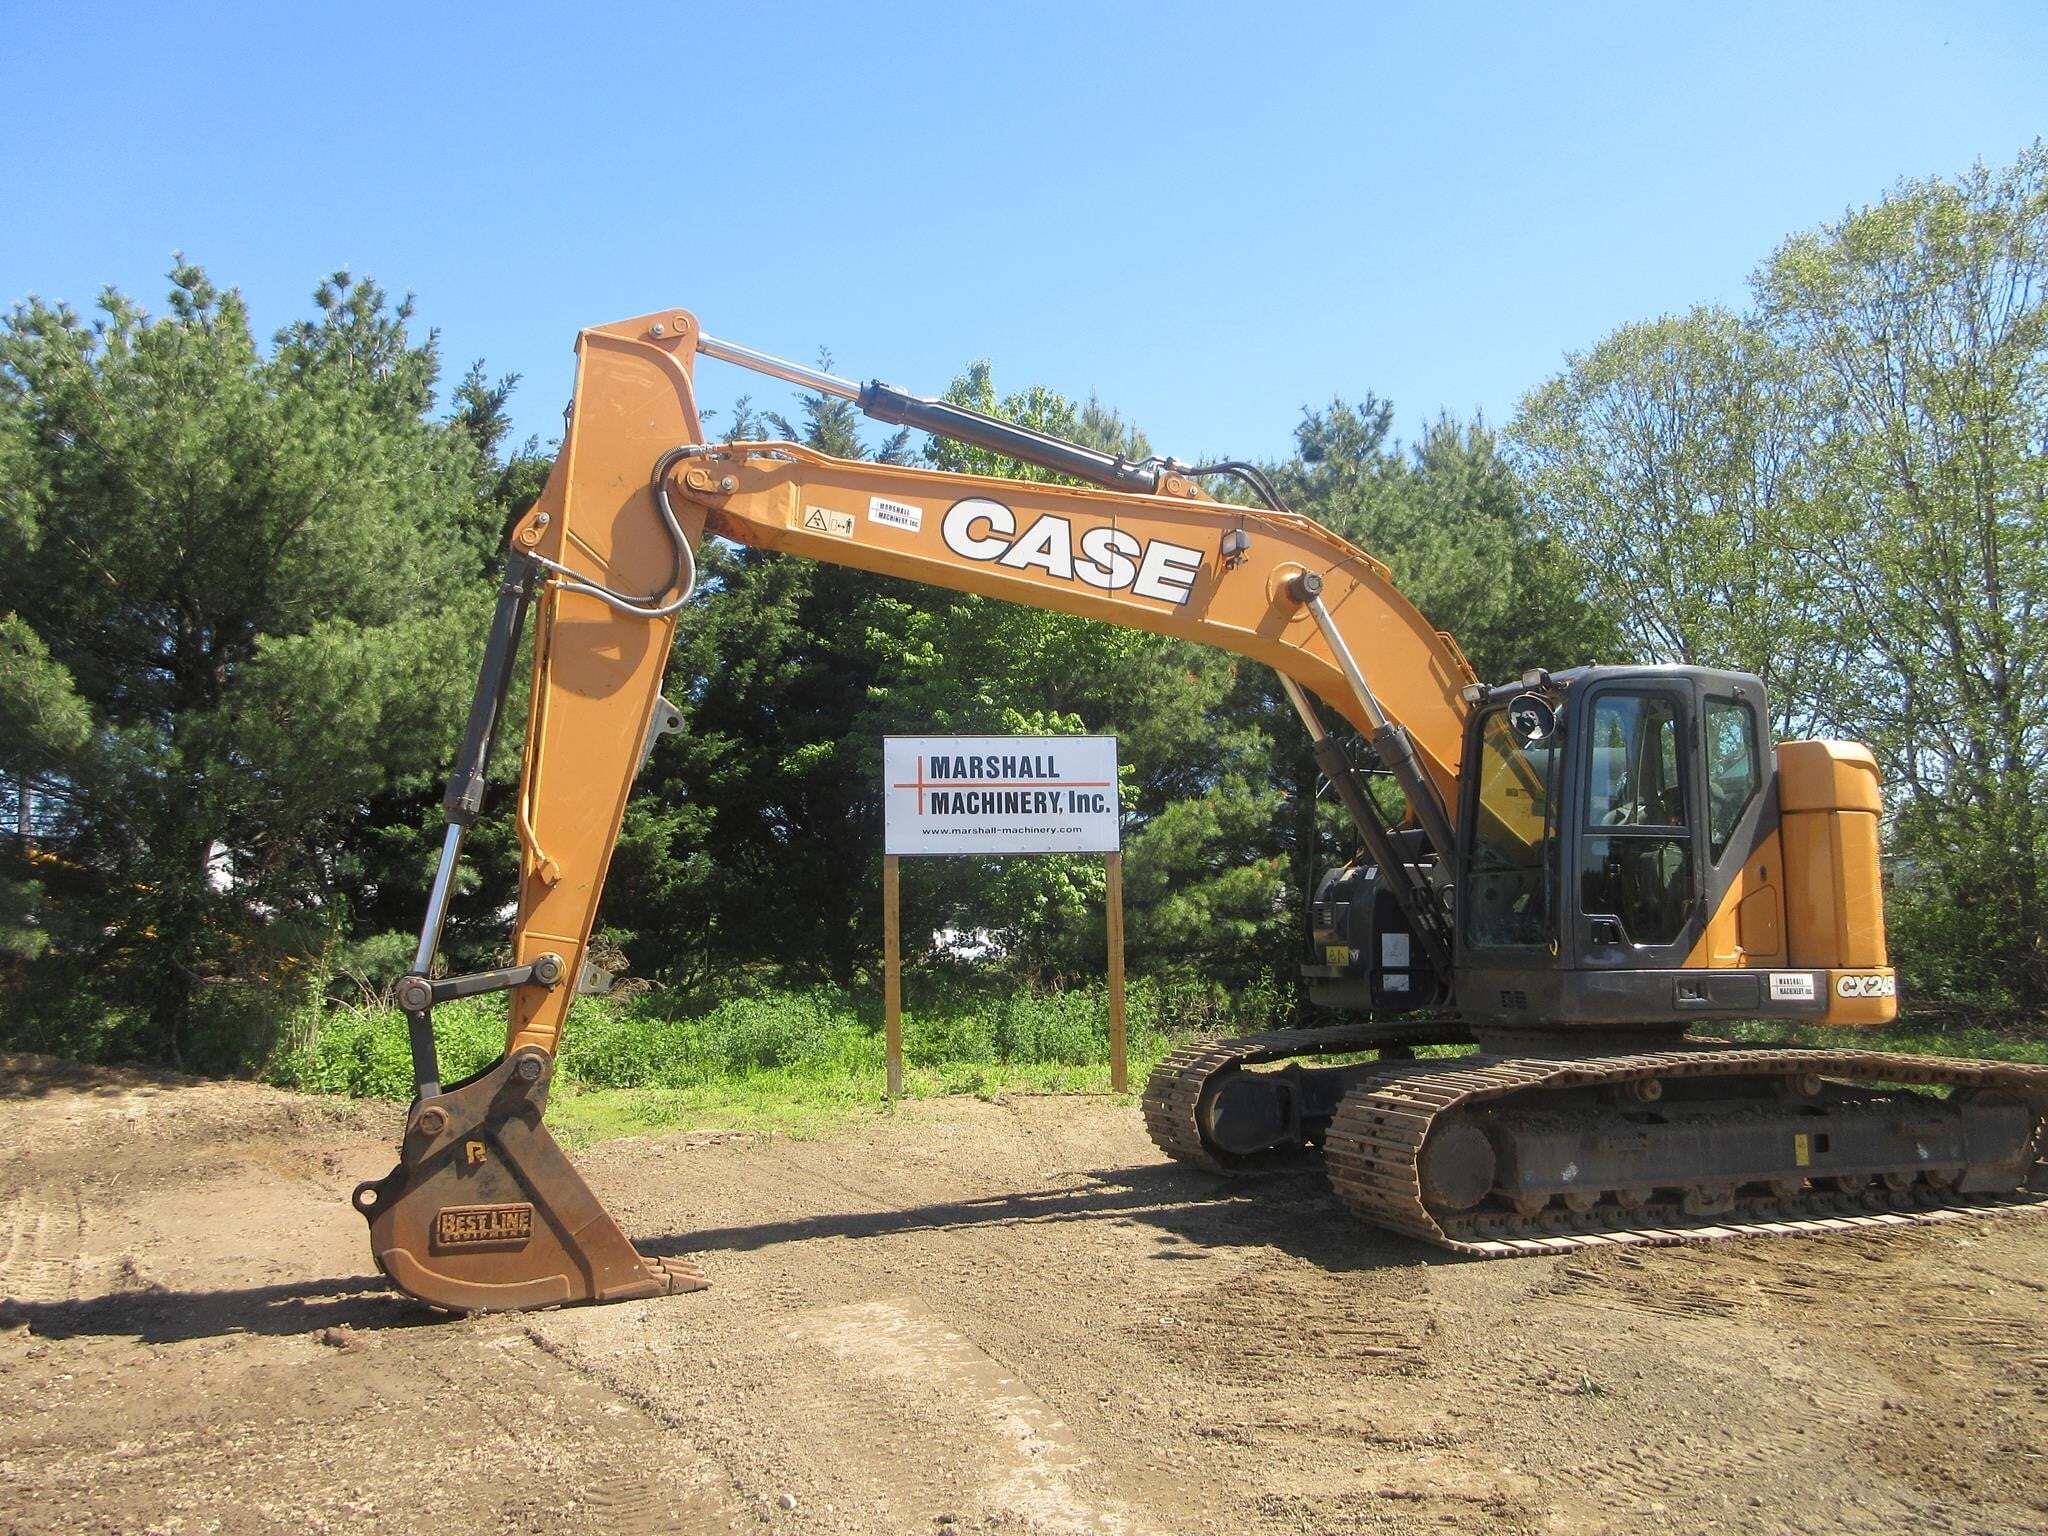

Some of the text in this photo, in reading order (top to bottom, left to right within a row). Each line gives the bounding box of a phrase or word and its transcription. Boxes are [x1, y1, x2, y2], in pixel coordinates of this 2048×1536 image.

[941, 496, 1205, 605] CASE
[930, 755, 1060, 779] MARSHALL
[931, 790, 1111, 816] MACHINERY, Inc.
[922, 826, 1083, 835] www.marshall-machinery.com
[442, 1211, 530, 1232] BEST LINE
